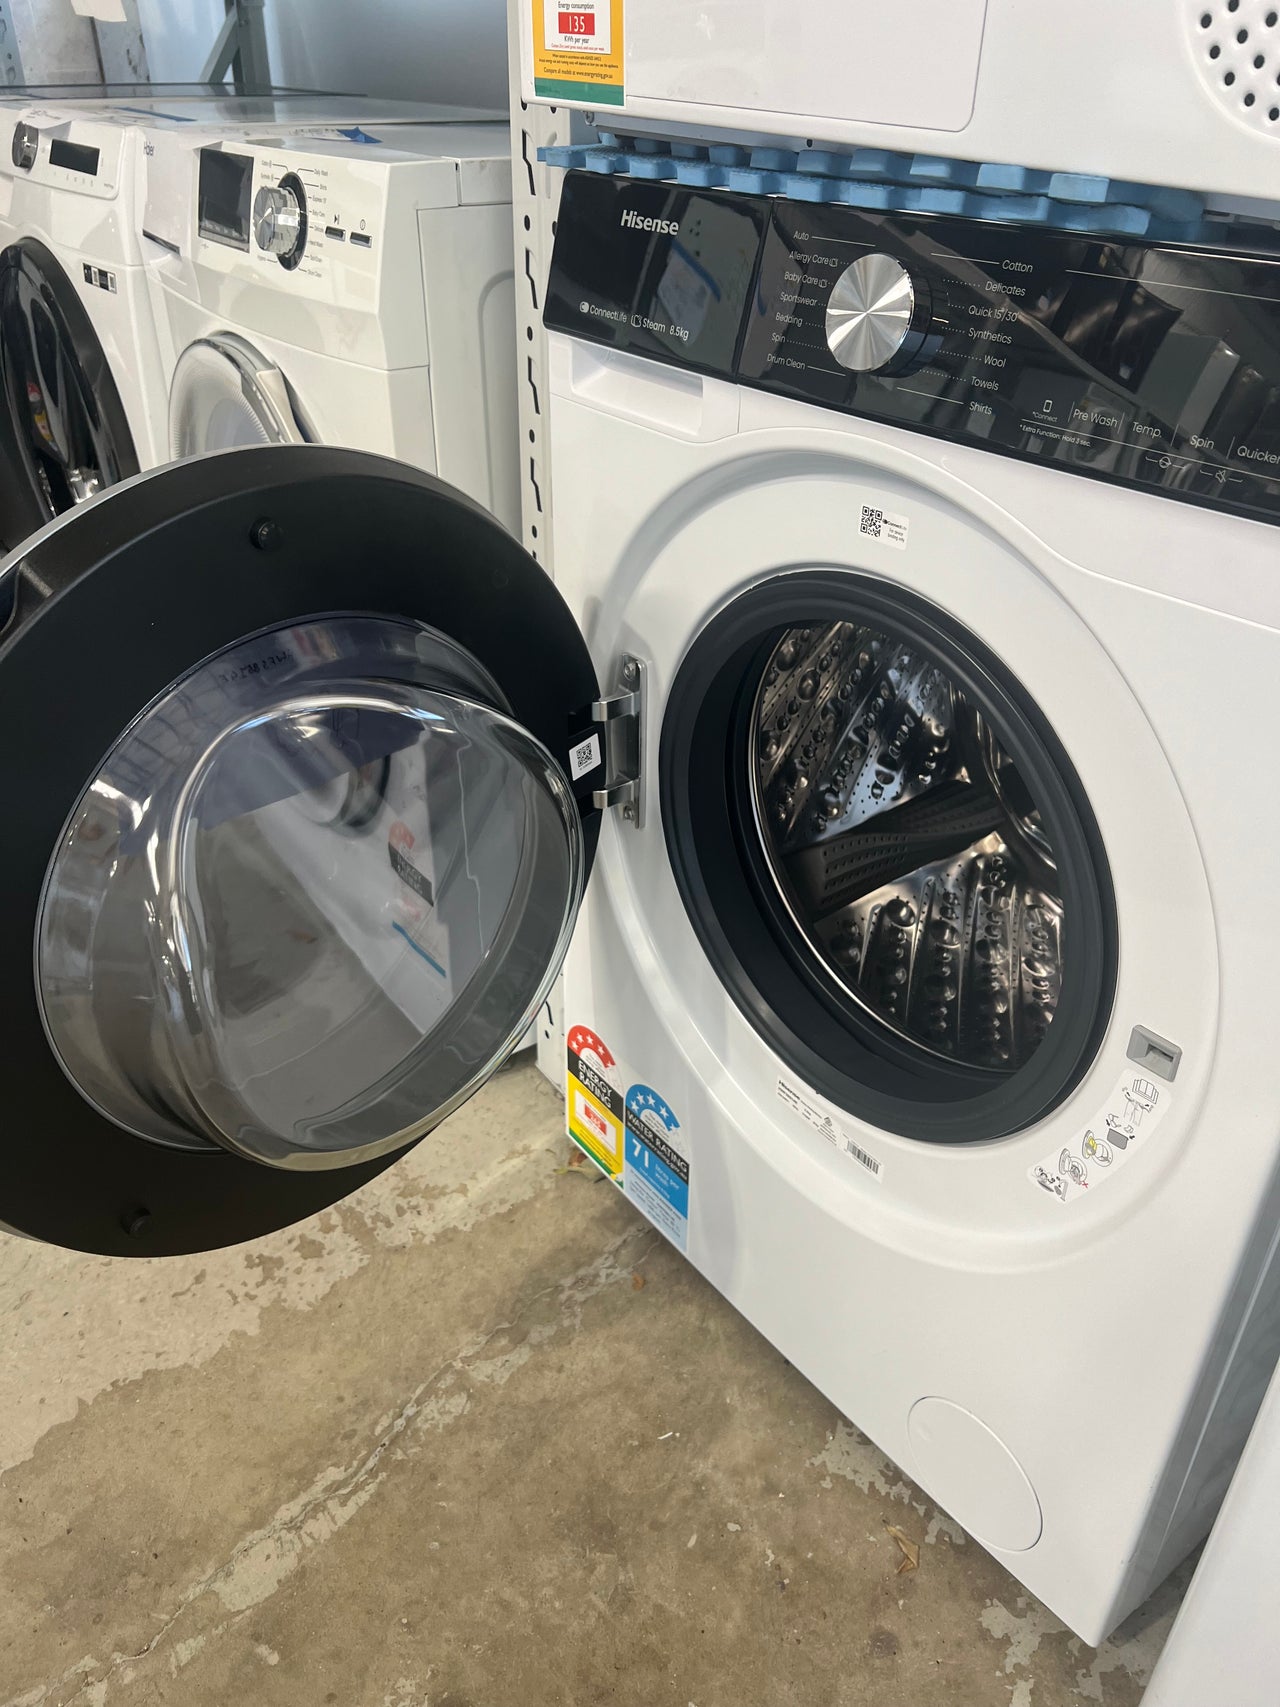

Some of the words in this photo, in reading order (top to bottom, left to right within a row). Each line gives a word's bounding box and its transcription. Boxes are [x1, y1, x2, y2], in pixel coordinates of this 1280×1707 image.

[569, 15, 585, 32] 135
[620, 209, 680, 236] Hisense
[793, 230, 810, 240] Auto
[789, 250, 812, 263] Allergy
[812, 254, 829, 265] Care
[1002, 260, 1033, 273] Cotton
[784, 271, 802, 284] Baby
[802, 274, 818, 285] Care
[985, 281, 1026, 296] Delicates
[780, 292, 818, 306] Sportswear
[968, 305, 992, 318] Quick
[590, 306, 628, 323] ConnectLife
[642, 318, 666, 333] Steam
[669, 325, 690, 341] 8.5kg
[776, 312, 802, 328] Bedding
[772, 332, 786, 343] Spin
[968, 328, 1012, 344] Synthetics
[767, 353, 785, 365] Drum
[786, 358, 806, 370] Clean
[984, 354, 1006, 368] Wool
[971, 376, 1000, 391] Towels
[969, 401, 992, 415] Shirts
[1073, 408, 1089, 421] Pre
[1090, 412, 1118, 427] Wash
[1132, 421, 1162, 439] Temp.
[1190, 434, 1215, 449] Spin
[578, 1060, 612, 1096] ENERGY
[579, 1071, 612, 1108] RATING
[627, 1110, 654, 1142] WATER
[656, 1138, 688, 1172] RATING
